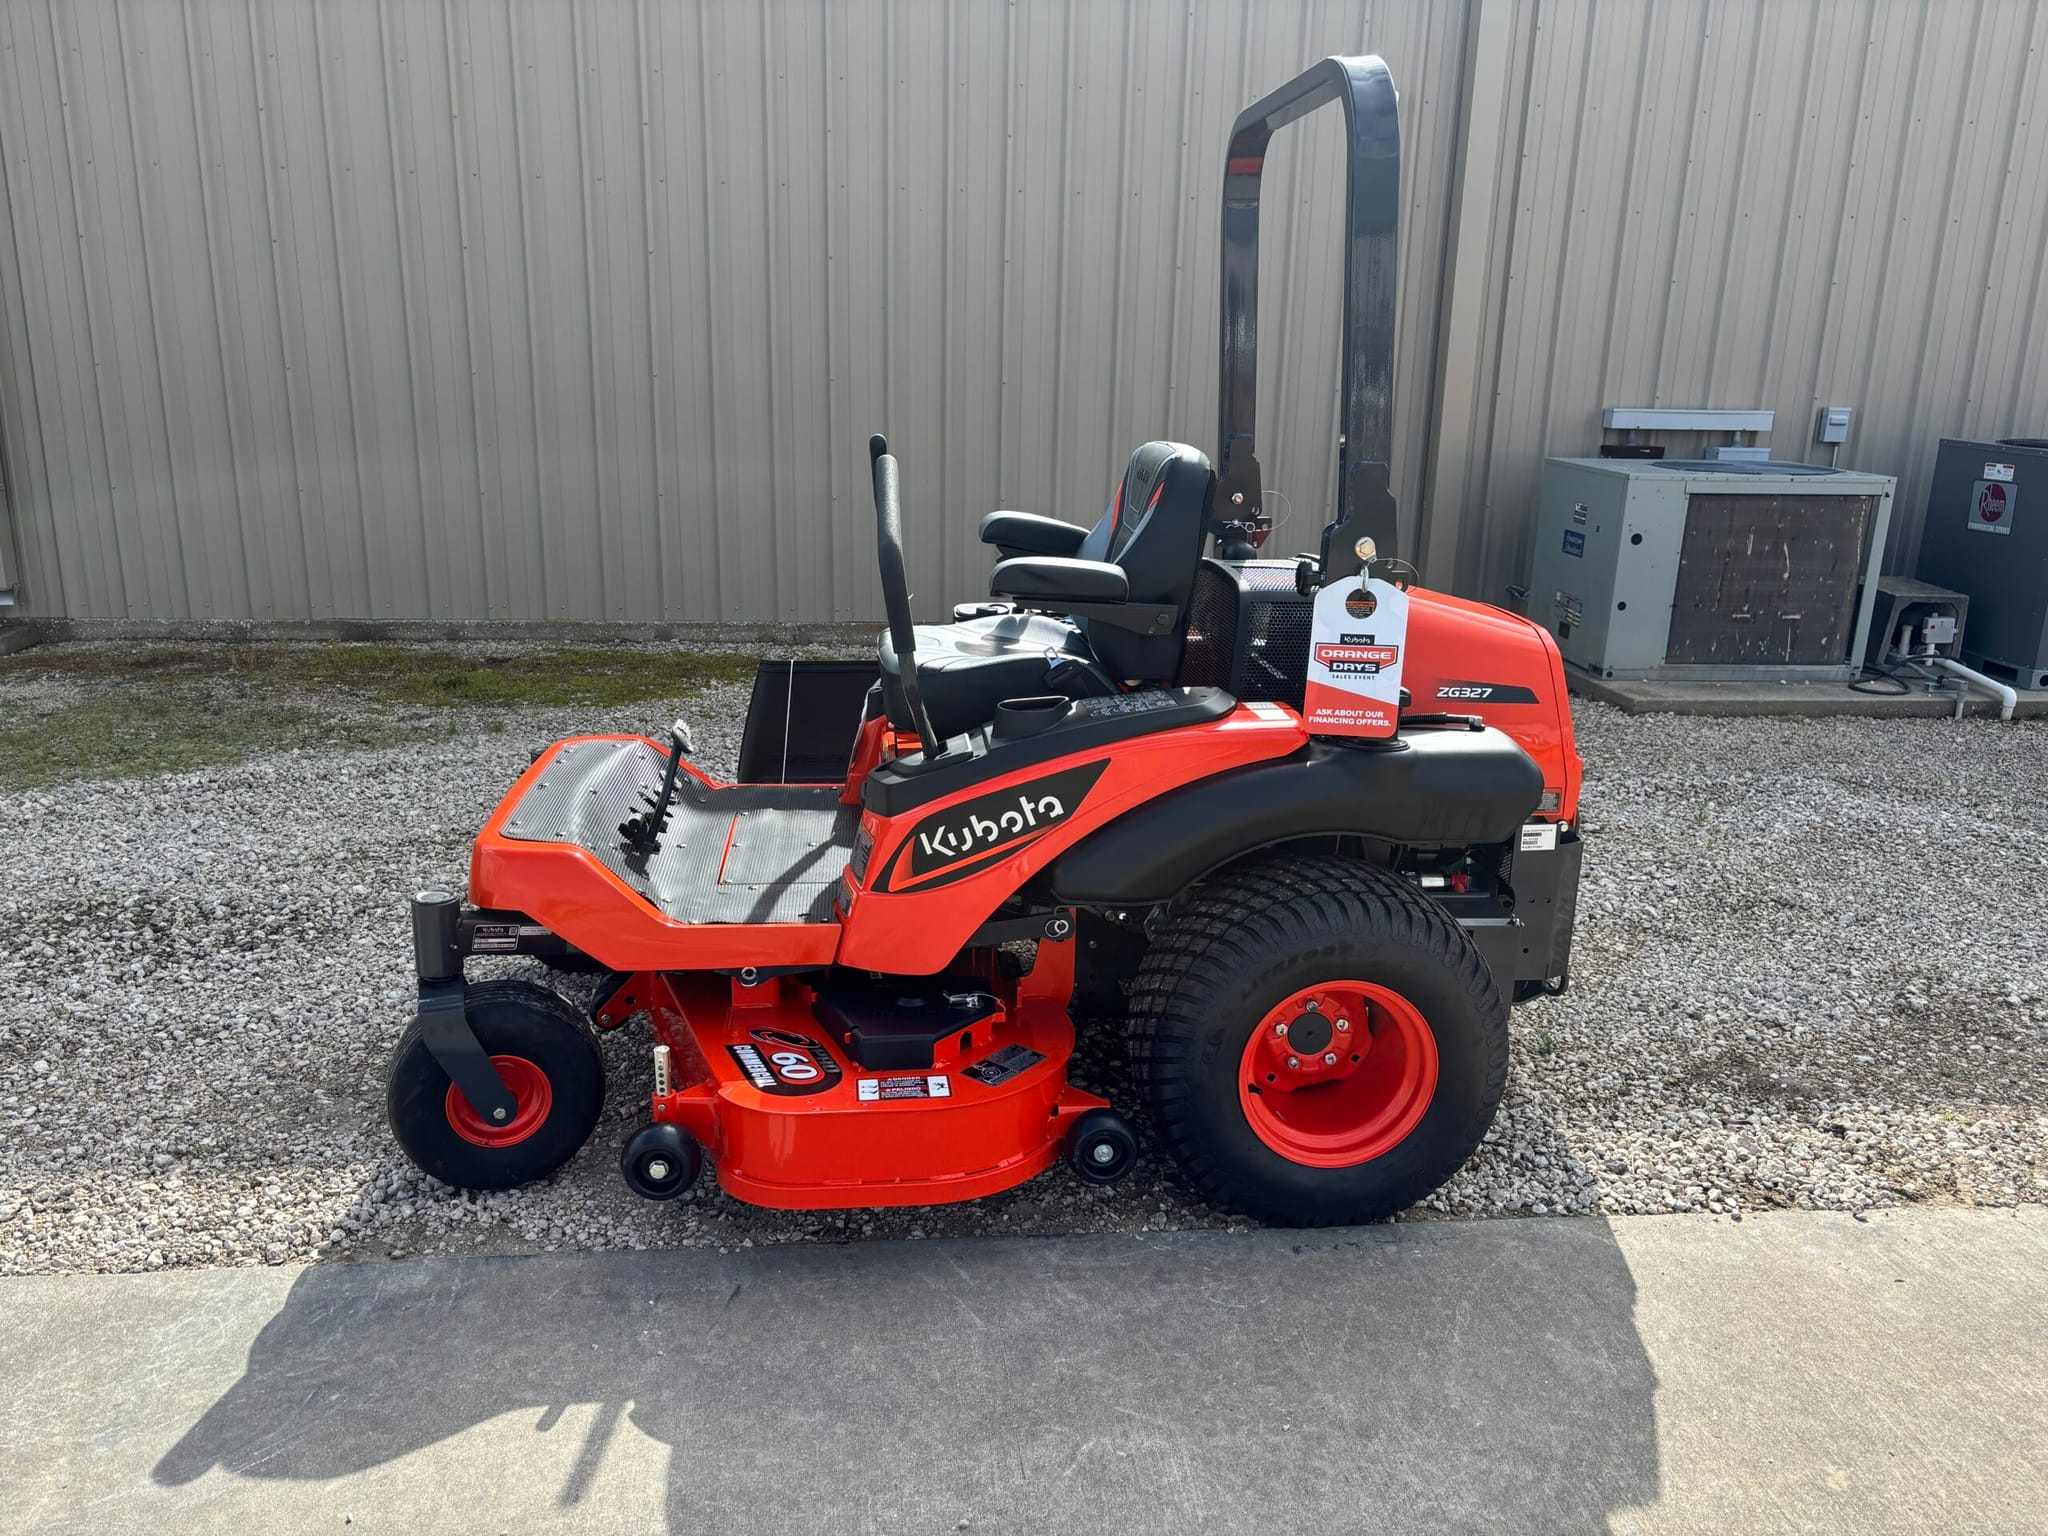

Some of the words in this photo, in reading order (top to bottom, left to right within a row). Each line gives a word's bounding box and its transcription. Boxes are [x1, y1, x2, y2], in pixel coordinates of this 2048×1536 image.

[1979, 484, 2005, 518] Rheem
[1344, 636, 1371, 644] Kubota
[1320, 649, 1393, 660] ORANGE
[1332, 662, 1377, 672] DAYS
[1436, 686, 1493, 698] ZG327
[1315, 708, 1333, 716] ASK
[1334, 709, 1364, 717] ABOUT
[1365, 710, 1385, 718] OUR
[1308, 716, 1354, 725] FINANCING
[1356, 719, 1391, 727] OFFERS.
[919, 795, 1065, 857] Kubota
[732, 1044, 778, 1089] COMMERCIAL
[771, 1052, 818, 1080] 60
